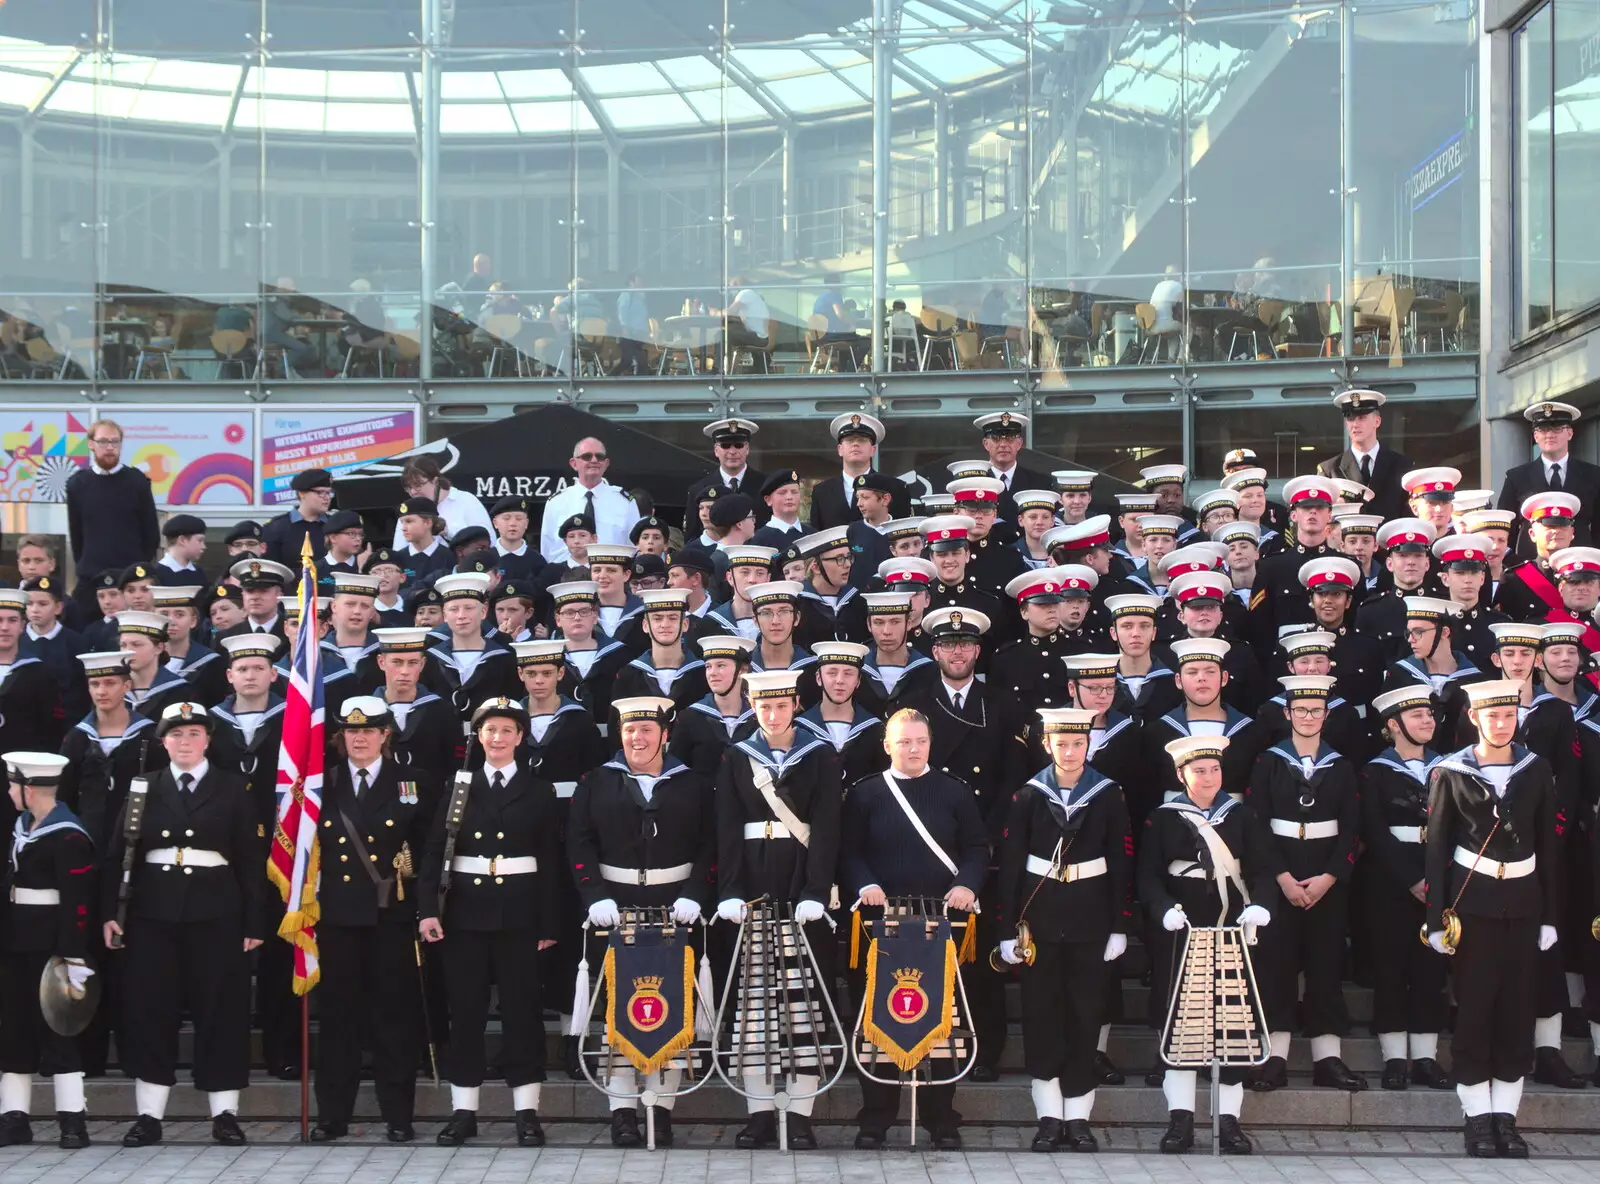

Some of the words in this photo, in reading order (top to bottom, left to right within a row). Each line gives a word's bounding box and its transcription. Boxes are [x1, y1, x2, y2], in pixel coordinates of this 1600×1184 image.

[273, 427, 335, 448] INTERACTIVE
[335, 417, 395, 437] EXHIBITIONS
[274, 446, 308, 461] MESSY
[308, 434, 376, 455] EXPERIMENTS
[273, 457, 325, 475] CELEBRITY
